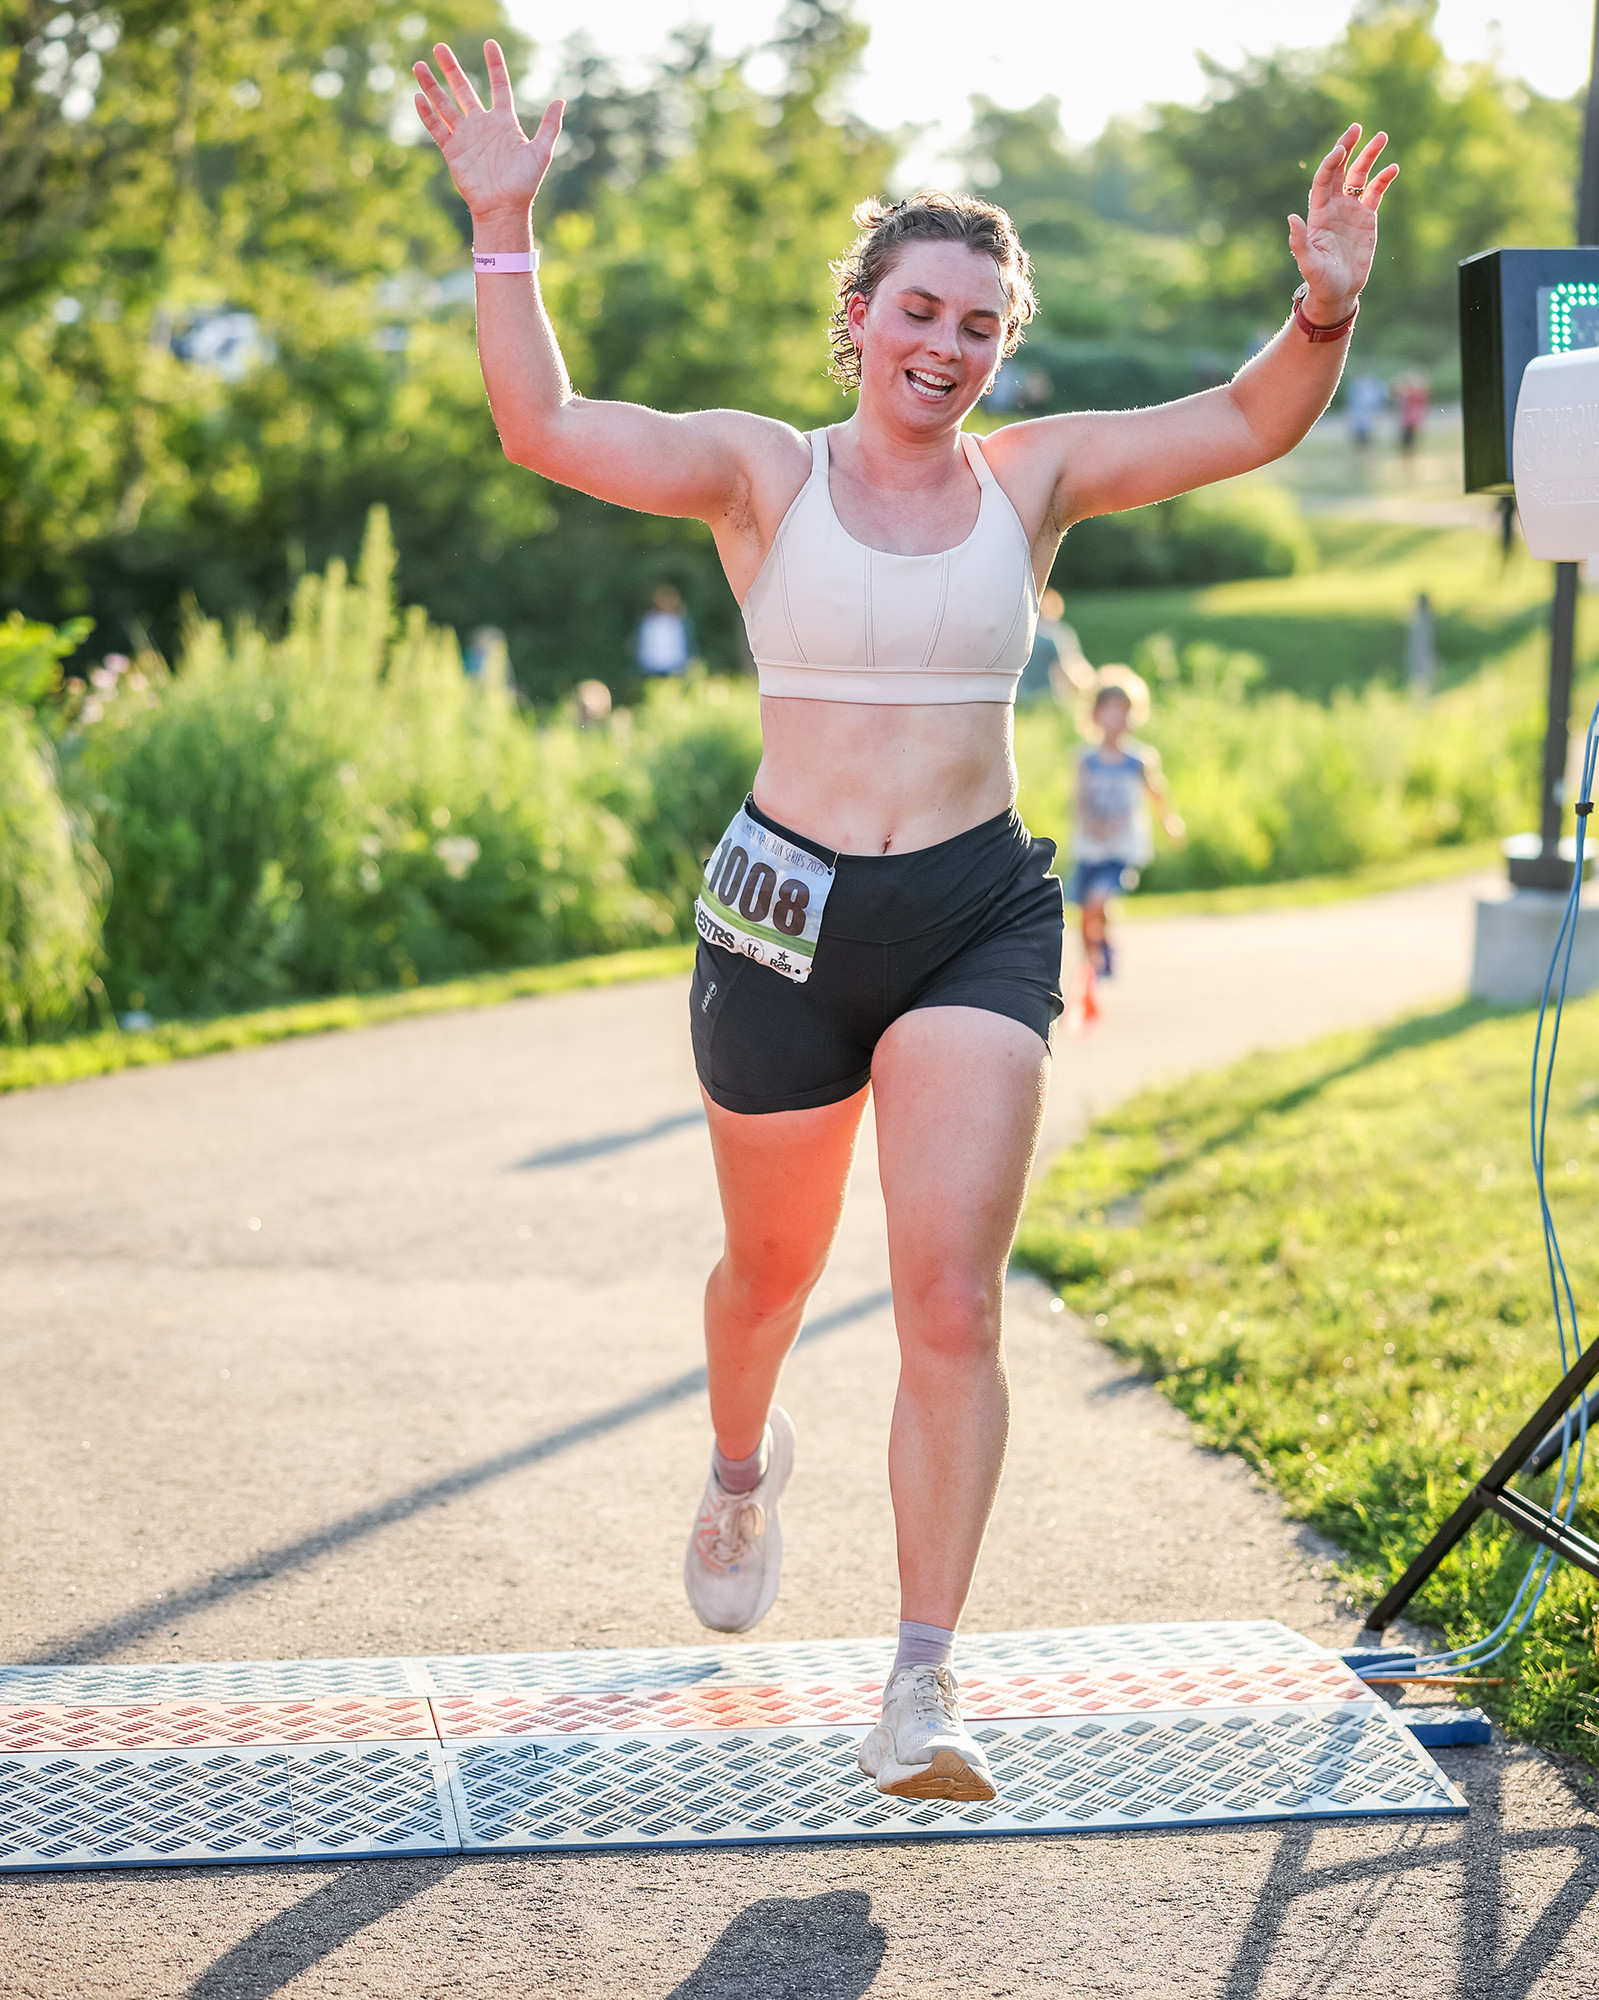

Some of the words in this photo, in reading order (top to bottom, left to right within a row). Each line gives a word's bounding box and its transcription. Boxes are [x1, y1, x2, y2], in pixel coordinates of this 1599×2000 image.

[708, 837, 810, 937] 1008
[756, 830, 771, 850] TRAIL
[770, 839, 784, 857] RUN
[784, 847, 805, 868] SERIES
[806, 858, 825, 877] 2025
